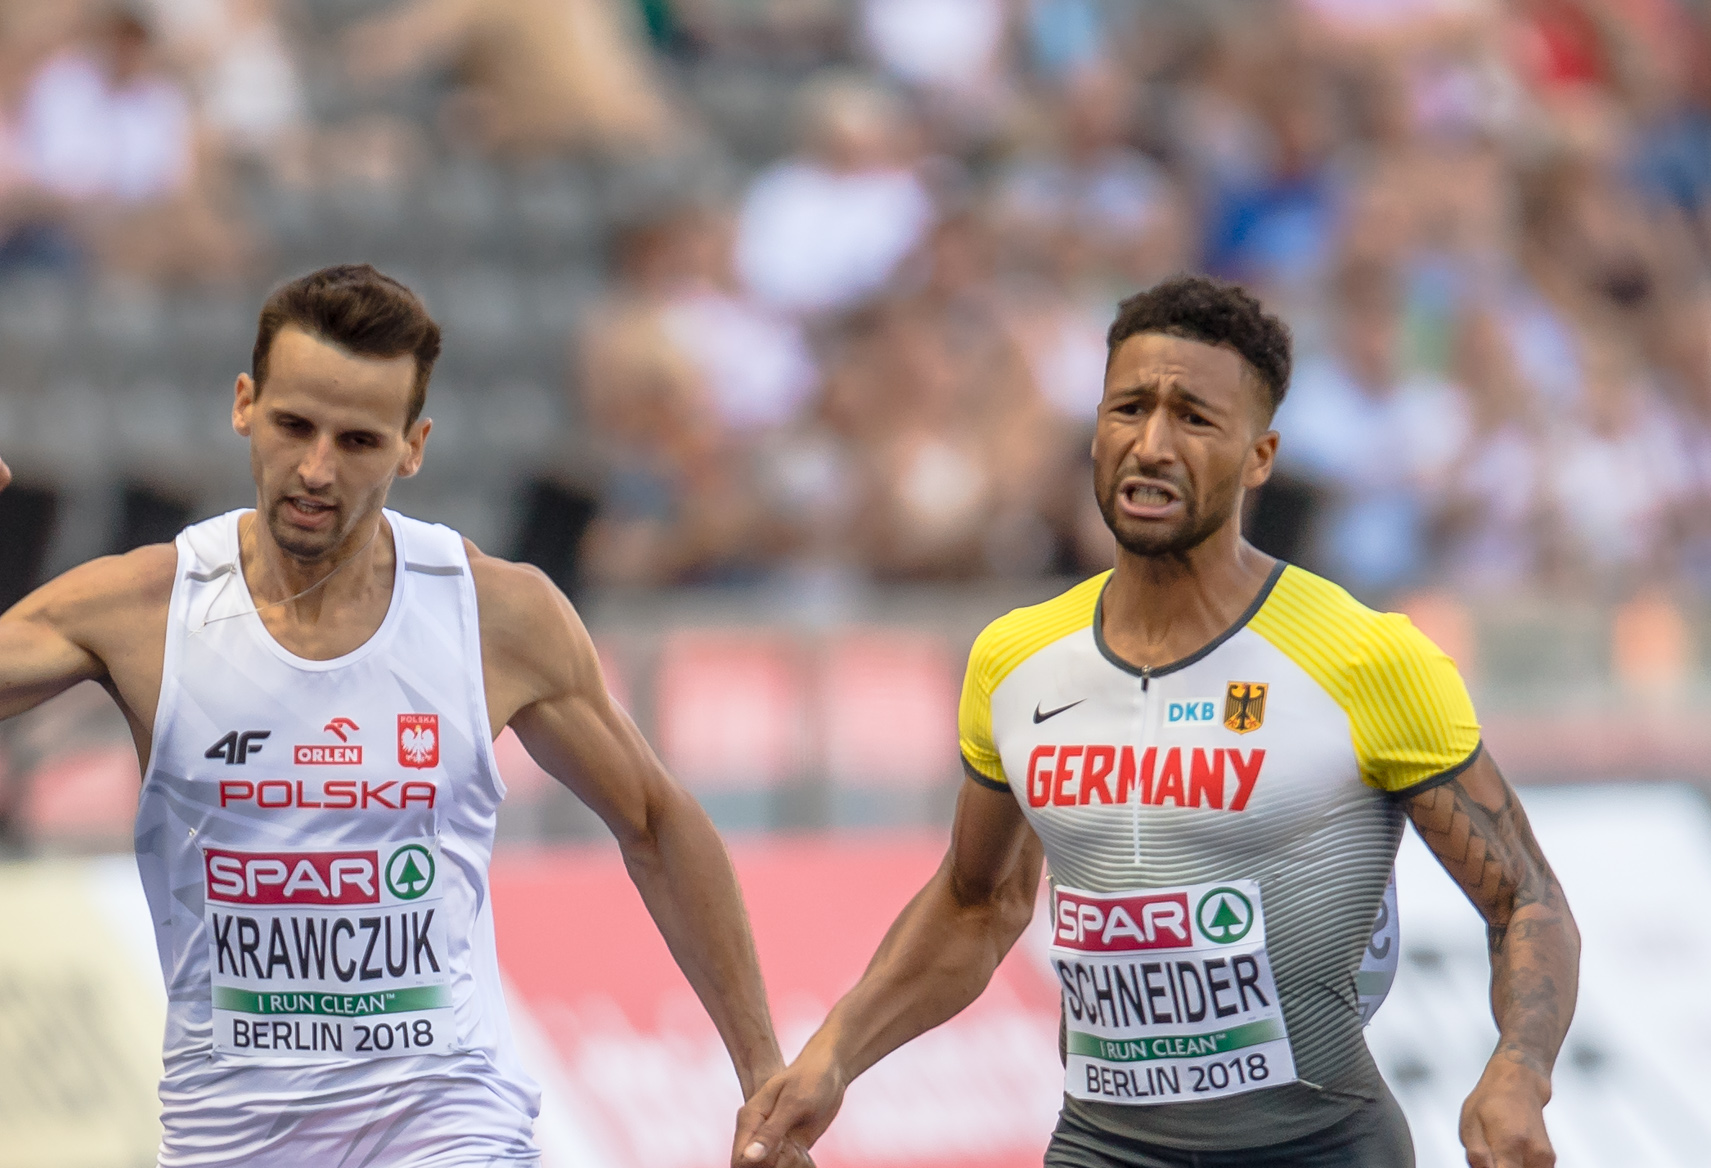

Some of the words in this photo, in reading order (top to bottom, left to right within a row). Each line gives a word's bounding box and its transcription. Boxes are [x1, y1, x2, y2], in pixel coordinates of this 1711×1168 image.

[400, 716, 435, 724] POLSKA
[1168, 701, 1214, 722] DKB
[204, 730, 271, 765] 4F
[297, 747, 358, 763] ORLEN
[219, 780, 437, 809] POLSKA
[1026, 744, 1266, 811] GERMANY
[209, 858, 374, 897] SPAR
[1058, 899, 1187, 945] SPAR
[212, 908, 440, 982] KRAWCZUK
[269, 994, 316, 1012] RUN
[1057, 953, 1270, 1027] SCHNEIDER
[232, 1018, 343, 1052] BERLIN
[354, 1019, 434, 1052] 2018
[1106, 1039, 1148, 1059] RUN
[1086, 1062, 1180, 1097] BERLIN
[1188, 1052, 1270, 1093] 2018
